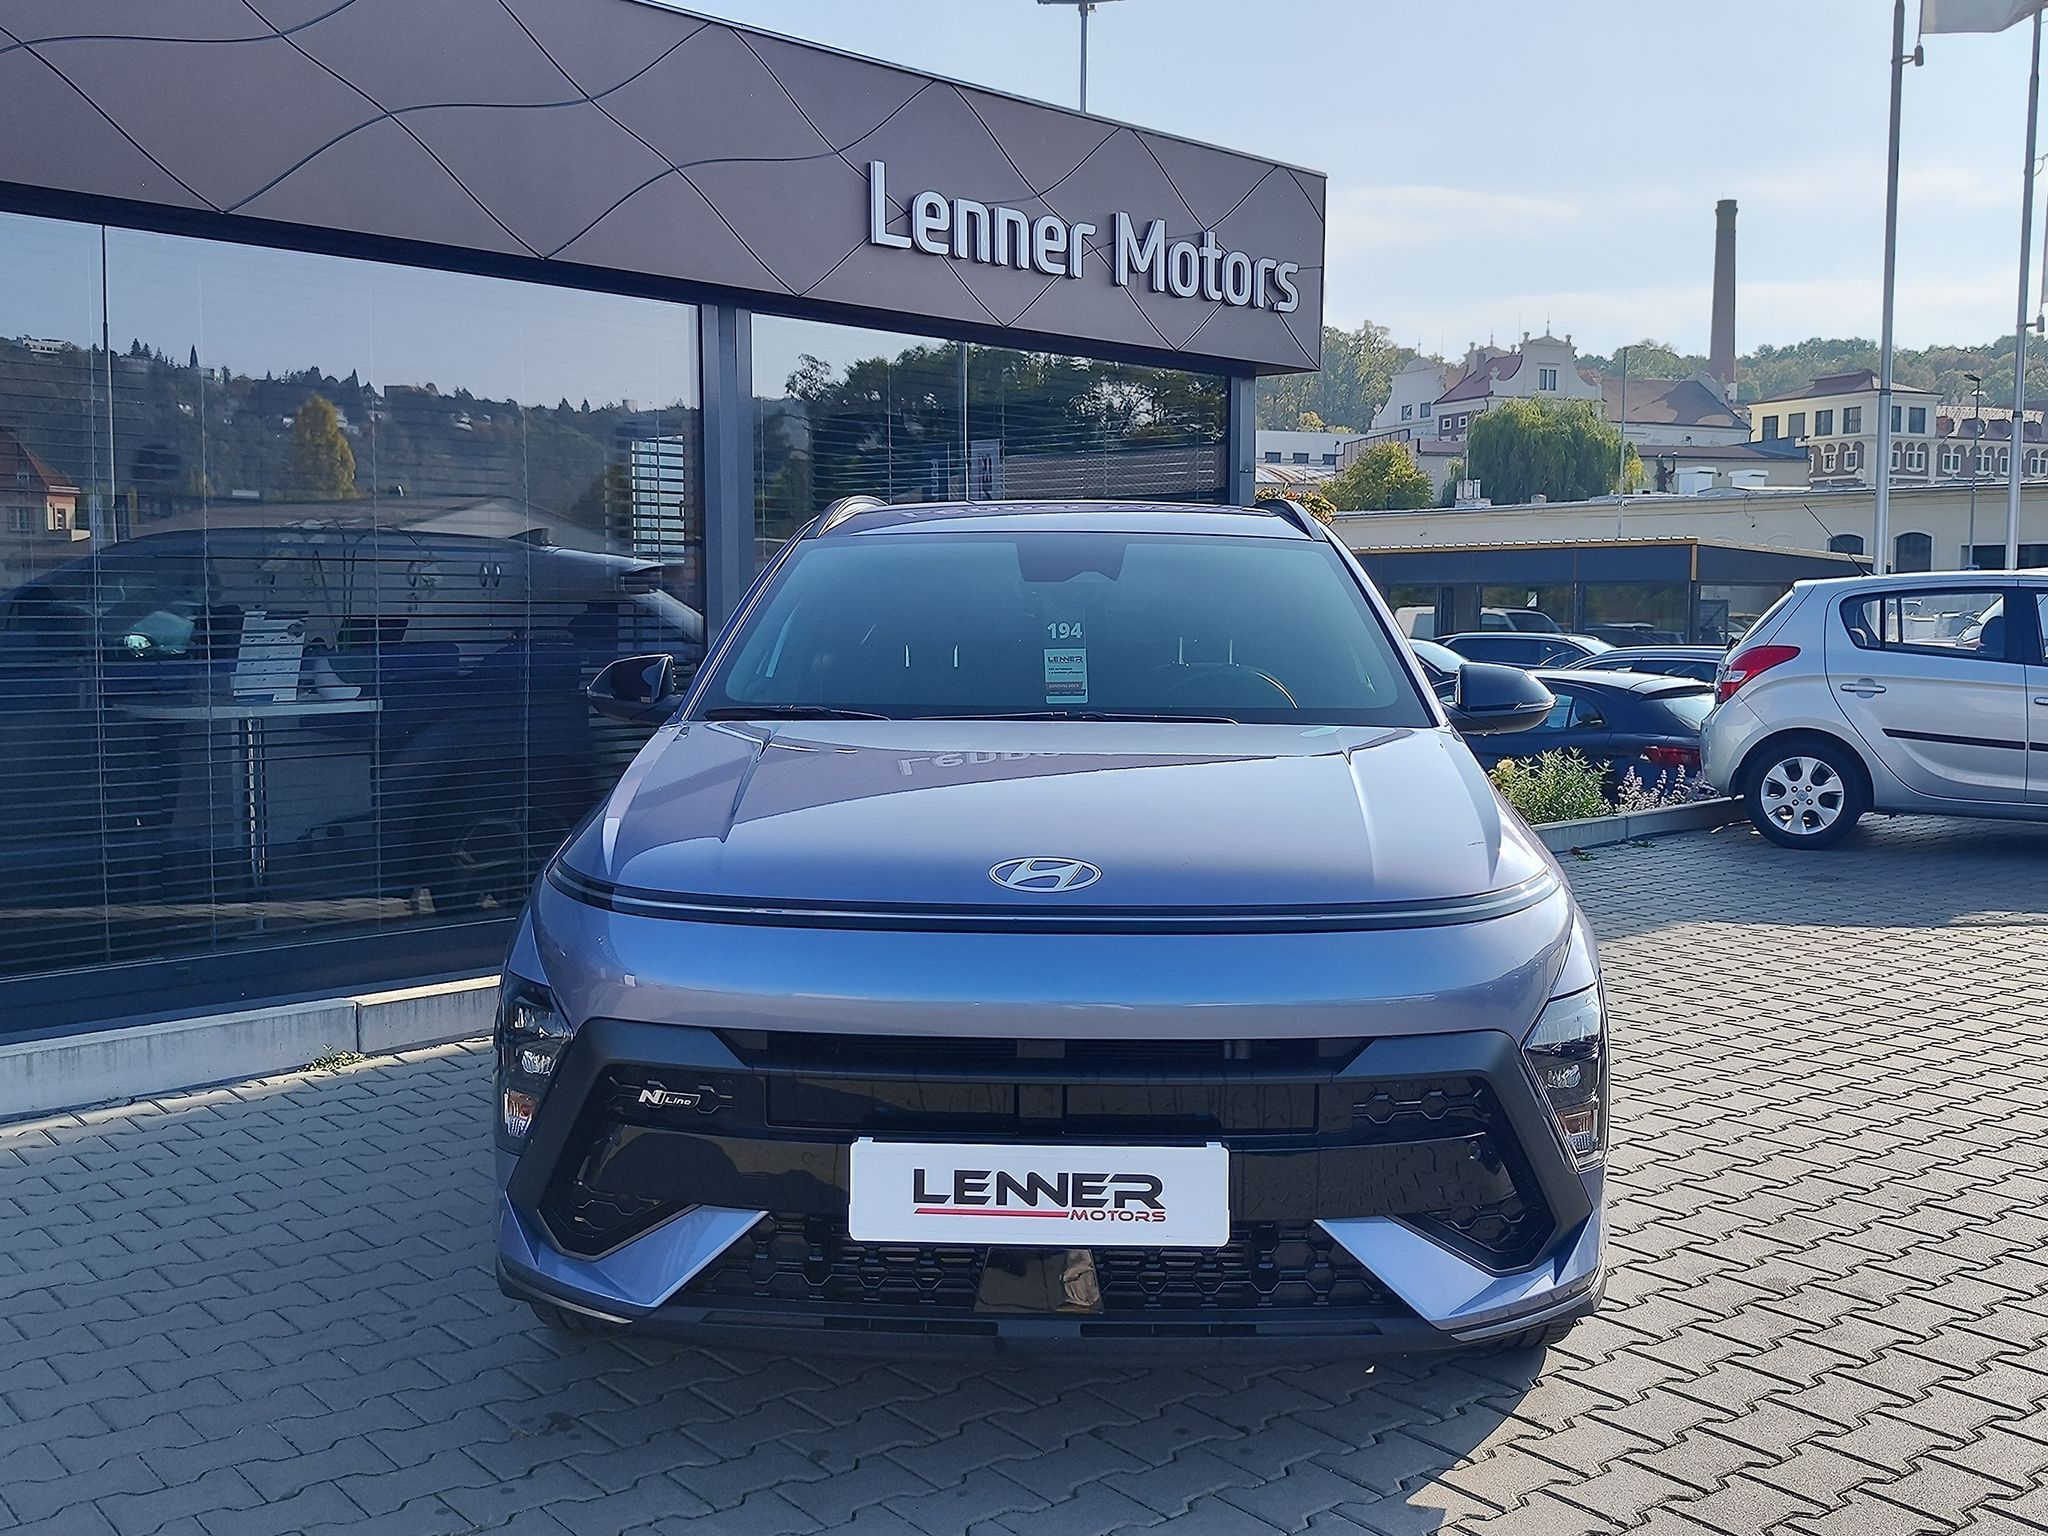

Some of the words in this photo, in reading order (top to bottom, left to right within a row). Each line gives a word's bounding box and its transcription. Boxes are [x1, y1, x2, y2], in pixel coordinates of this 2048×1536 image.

[867, 160, 1096, 279] Lenner
[1113, 211, 1299, 313] Motors
[1047, 622, 1083, 639] 194
[665, 1096, 692, 1106] Line
[913, 1168, 1166, 1209] LENNER
[1069, 1208, 1166, 1223] MOTORS
